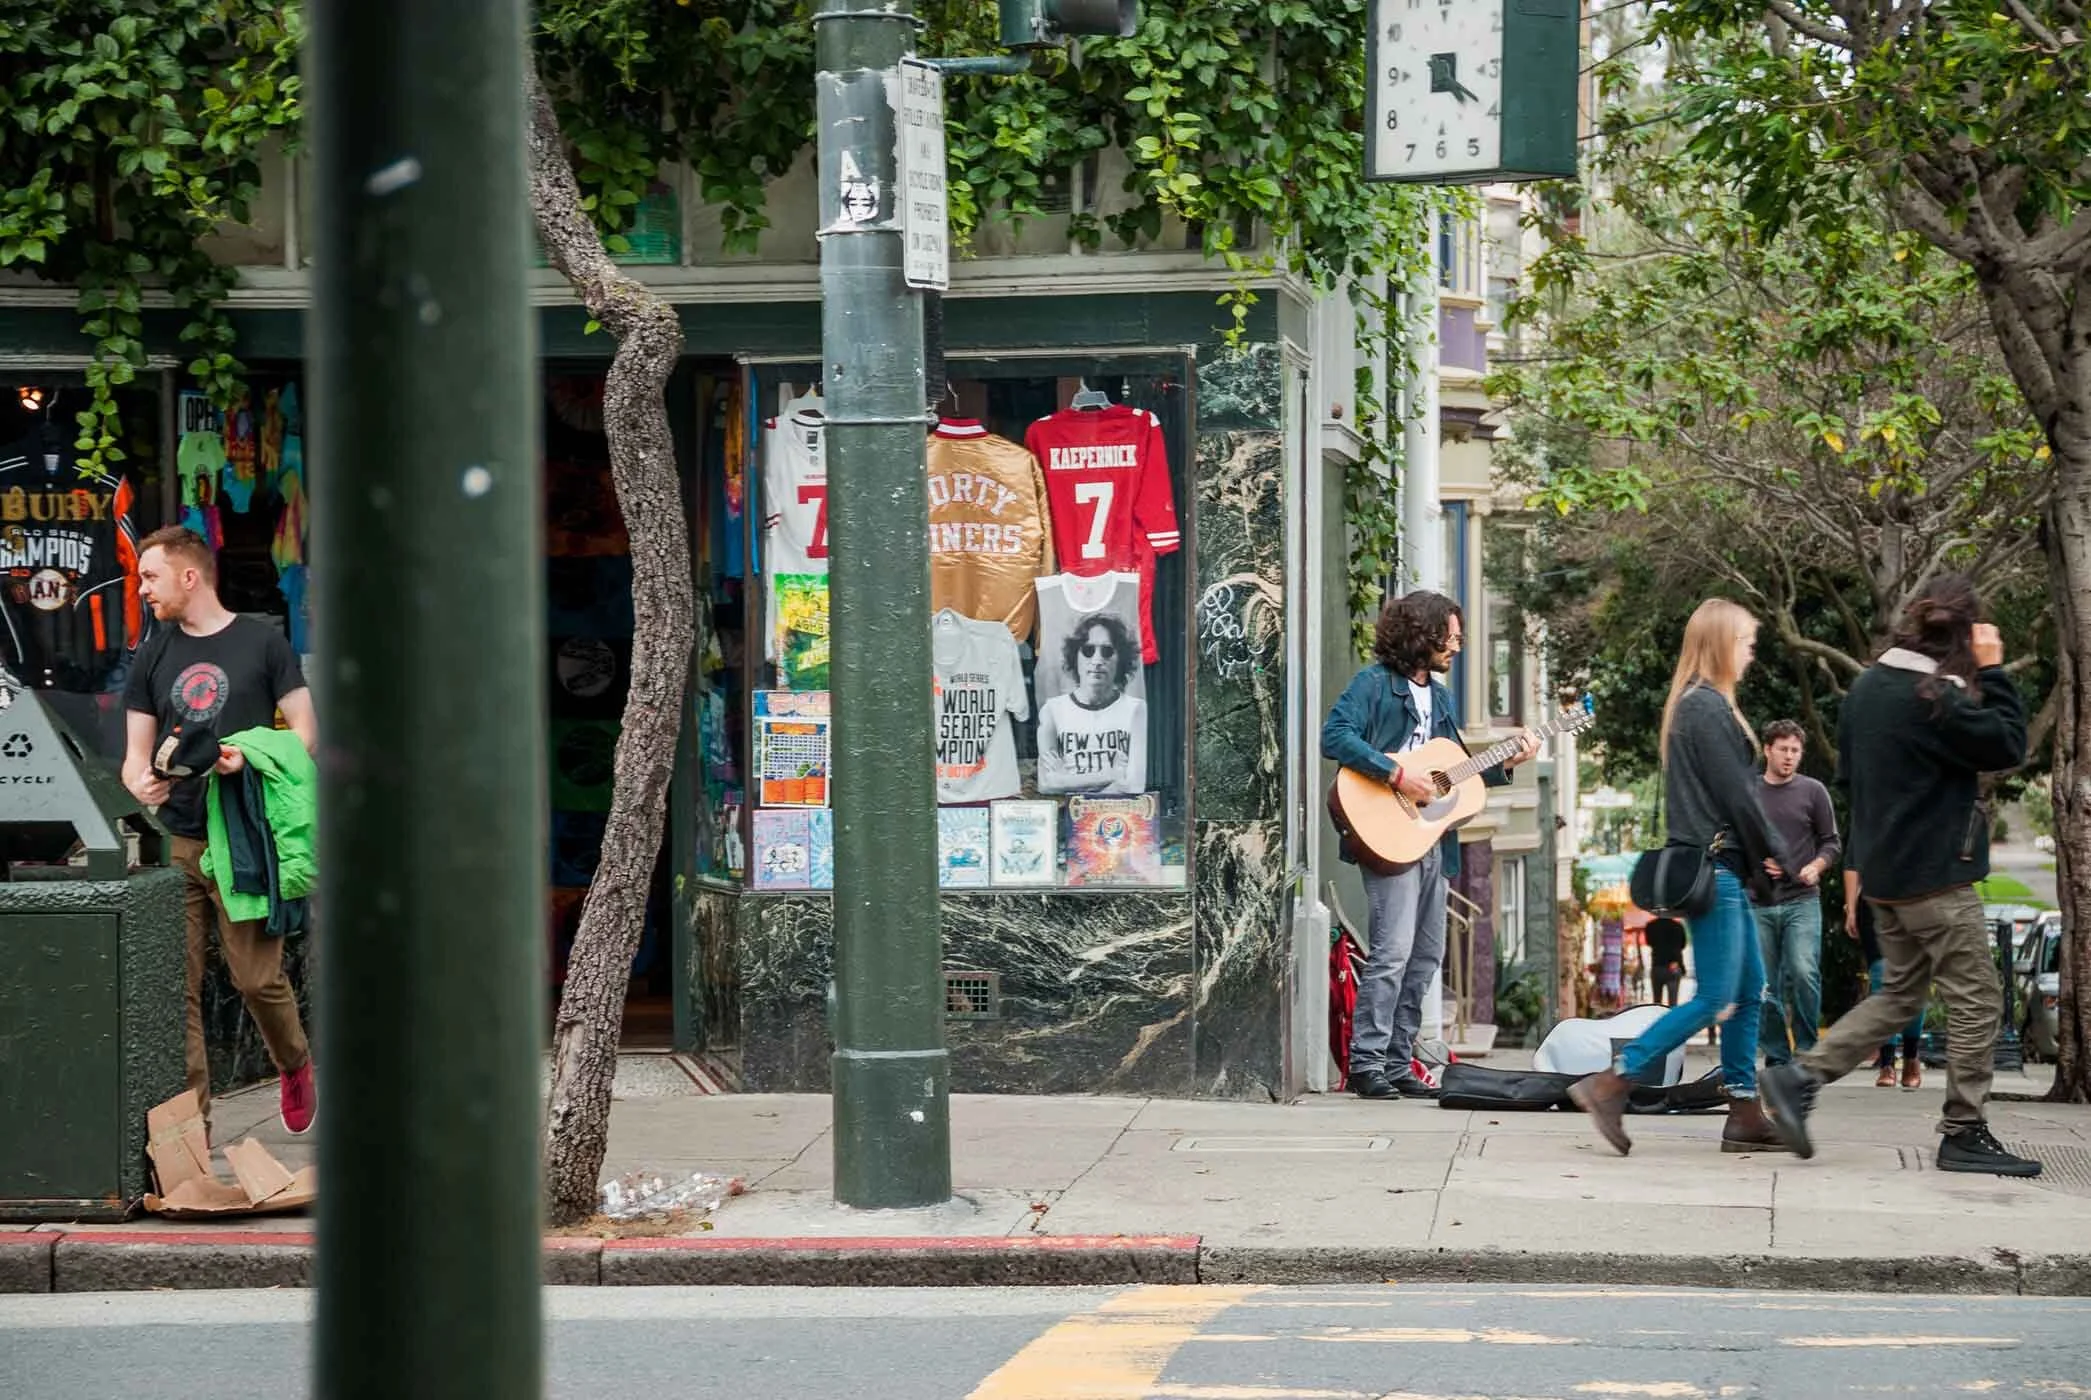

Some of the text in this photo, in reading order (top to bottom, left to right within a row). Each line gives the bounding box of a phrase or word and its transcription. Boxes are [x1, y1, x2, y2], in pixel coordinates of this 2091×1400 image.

[1491, 11, 1502, 32] 2
[1388, 67, 1399, 86] 9
[1489, 59, 1501, 79] 3
[1387, 110, 1398, 130] 8
[1486, 103, 1502, 120] 4
[1406, 144, 1416, 162] 7
[1436, 141, 1447, 159] 6
[1467, 138, 1480, 157] 5
[1050, 445, 1137, 470] KAEPERNICK
[929, 472, 1017, 516] ORTY
[797, 485, 828, 558] 7
[1075, 482, 1114, 559] 7
[943, 689, 995, 714] WORLD
[940, 714, 996, 739] SERIES
[1058, 731, 1089, 758] NEW
[1075, 750, 1117, 775] CITY
